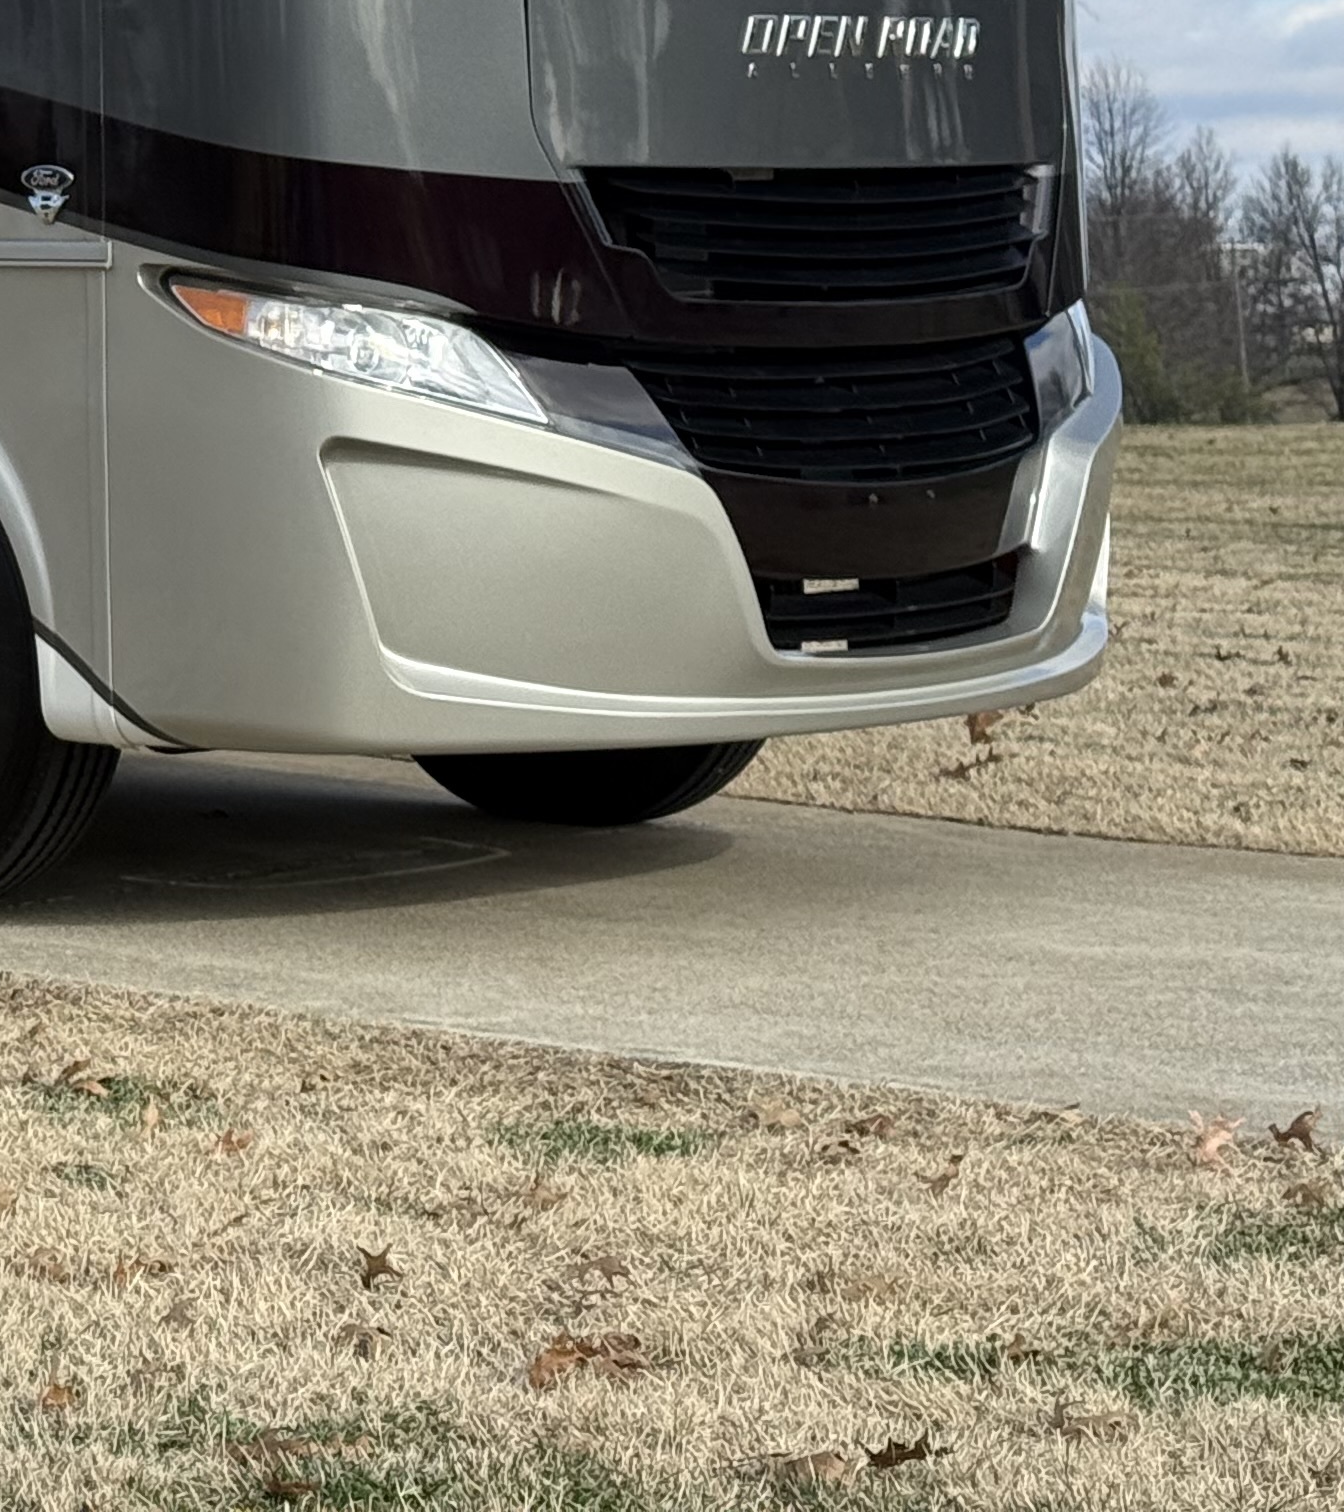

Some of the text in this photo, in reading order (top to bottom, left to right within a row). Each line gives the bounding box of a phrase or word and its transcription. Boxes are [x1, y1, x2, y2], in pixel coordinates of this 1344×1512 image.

[742, 14, 980, 58] OPEN ROAD
[30, 168, 60, 187] Ford
